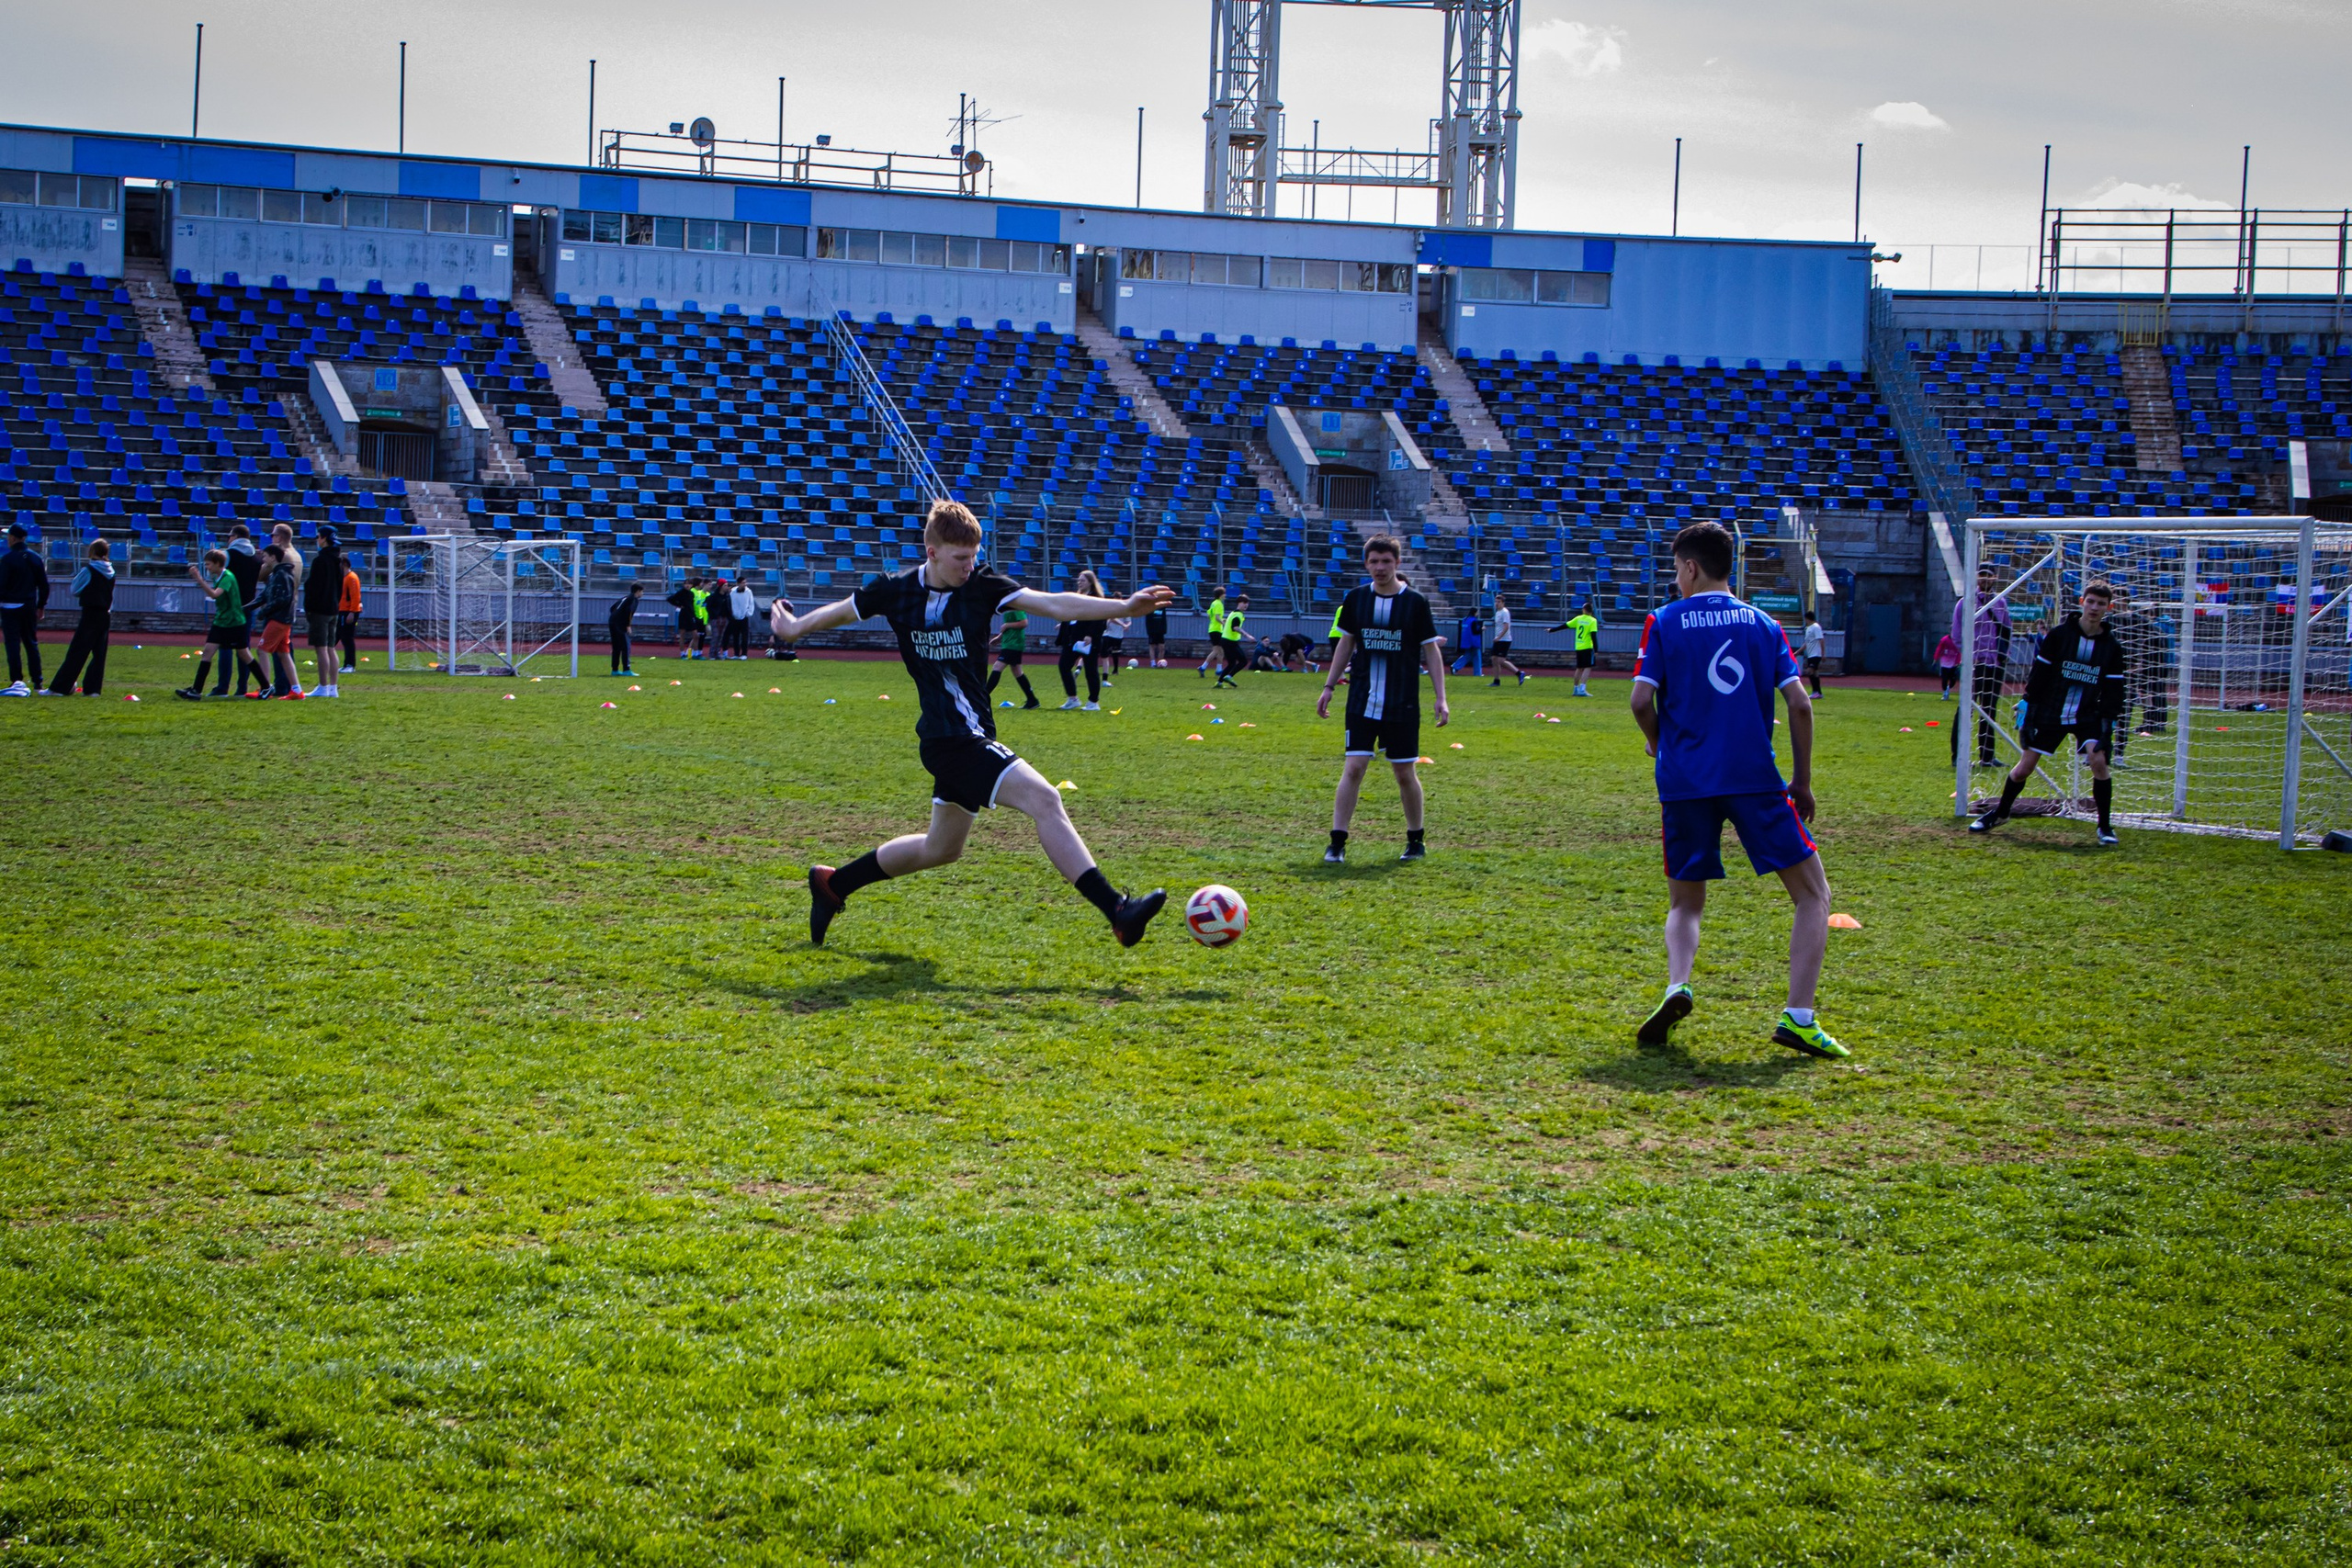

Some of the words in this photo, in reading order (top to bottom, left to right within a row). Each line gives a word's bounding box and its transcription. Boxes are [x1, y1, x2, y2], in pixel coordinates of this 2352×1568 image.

[378, 373, 394, 385] 10
[1326, 416, 1338, 427] 11
[1680, 607, 1756, 629] БОБОХОНОВ
[910, 626, 964, 646] СЕВЕРНЫЙ
[1577, 626, 1584, 639] 2
[915, 644, 967, 660] ЧЕЛОВЕК
[1707, 638, 1745, 694] 6
[2062, 660, 2101, 676] СЕВЕРНЫЙ
[2062, 670, 2098, 684] ЧЕЛОВЕК
[985, 741, 1015, 759] 13
